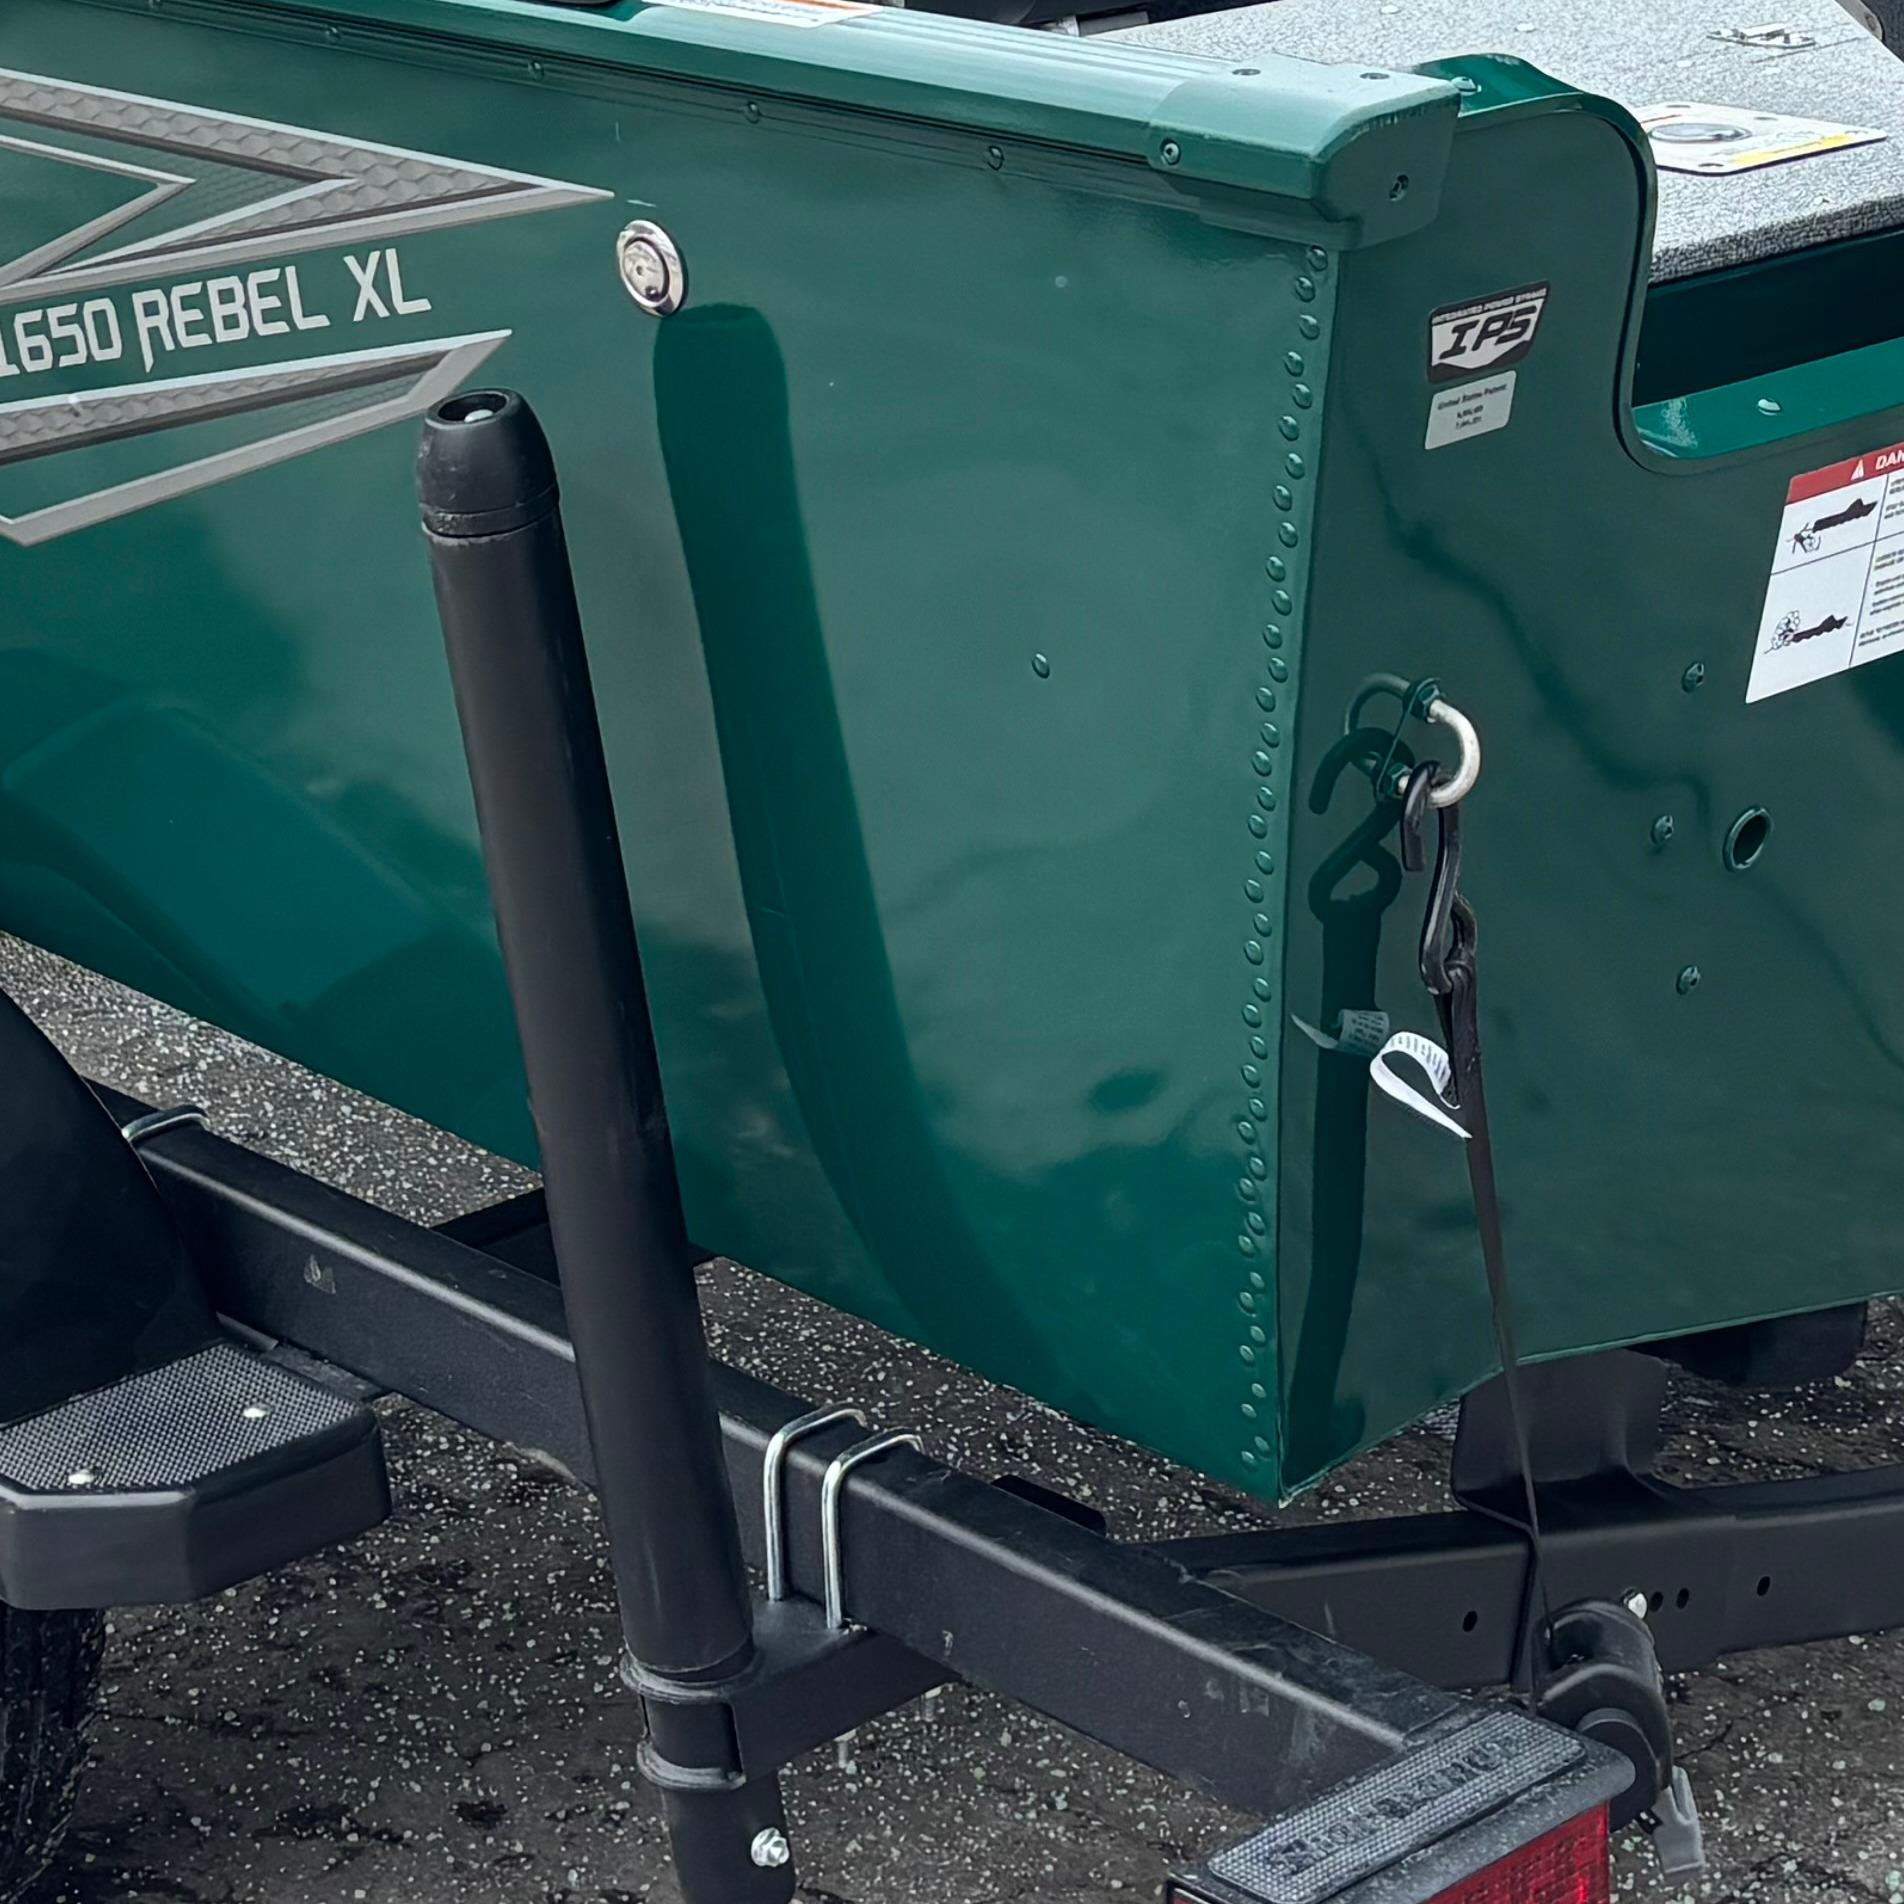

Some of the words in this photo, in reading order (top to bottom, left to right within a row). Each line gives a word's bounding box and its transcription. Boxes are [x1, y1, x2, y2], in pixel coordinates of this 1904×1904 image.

[132, 264, 332, 371] REBEL
[341, 246, 433, 321] XL
[1438, 304, 1538, 361] IPS
